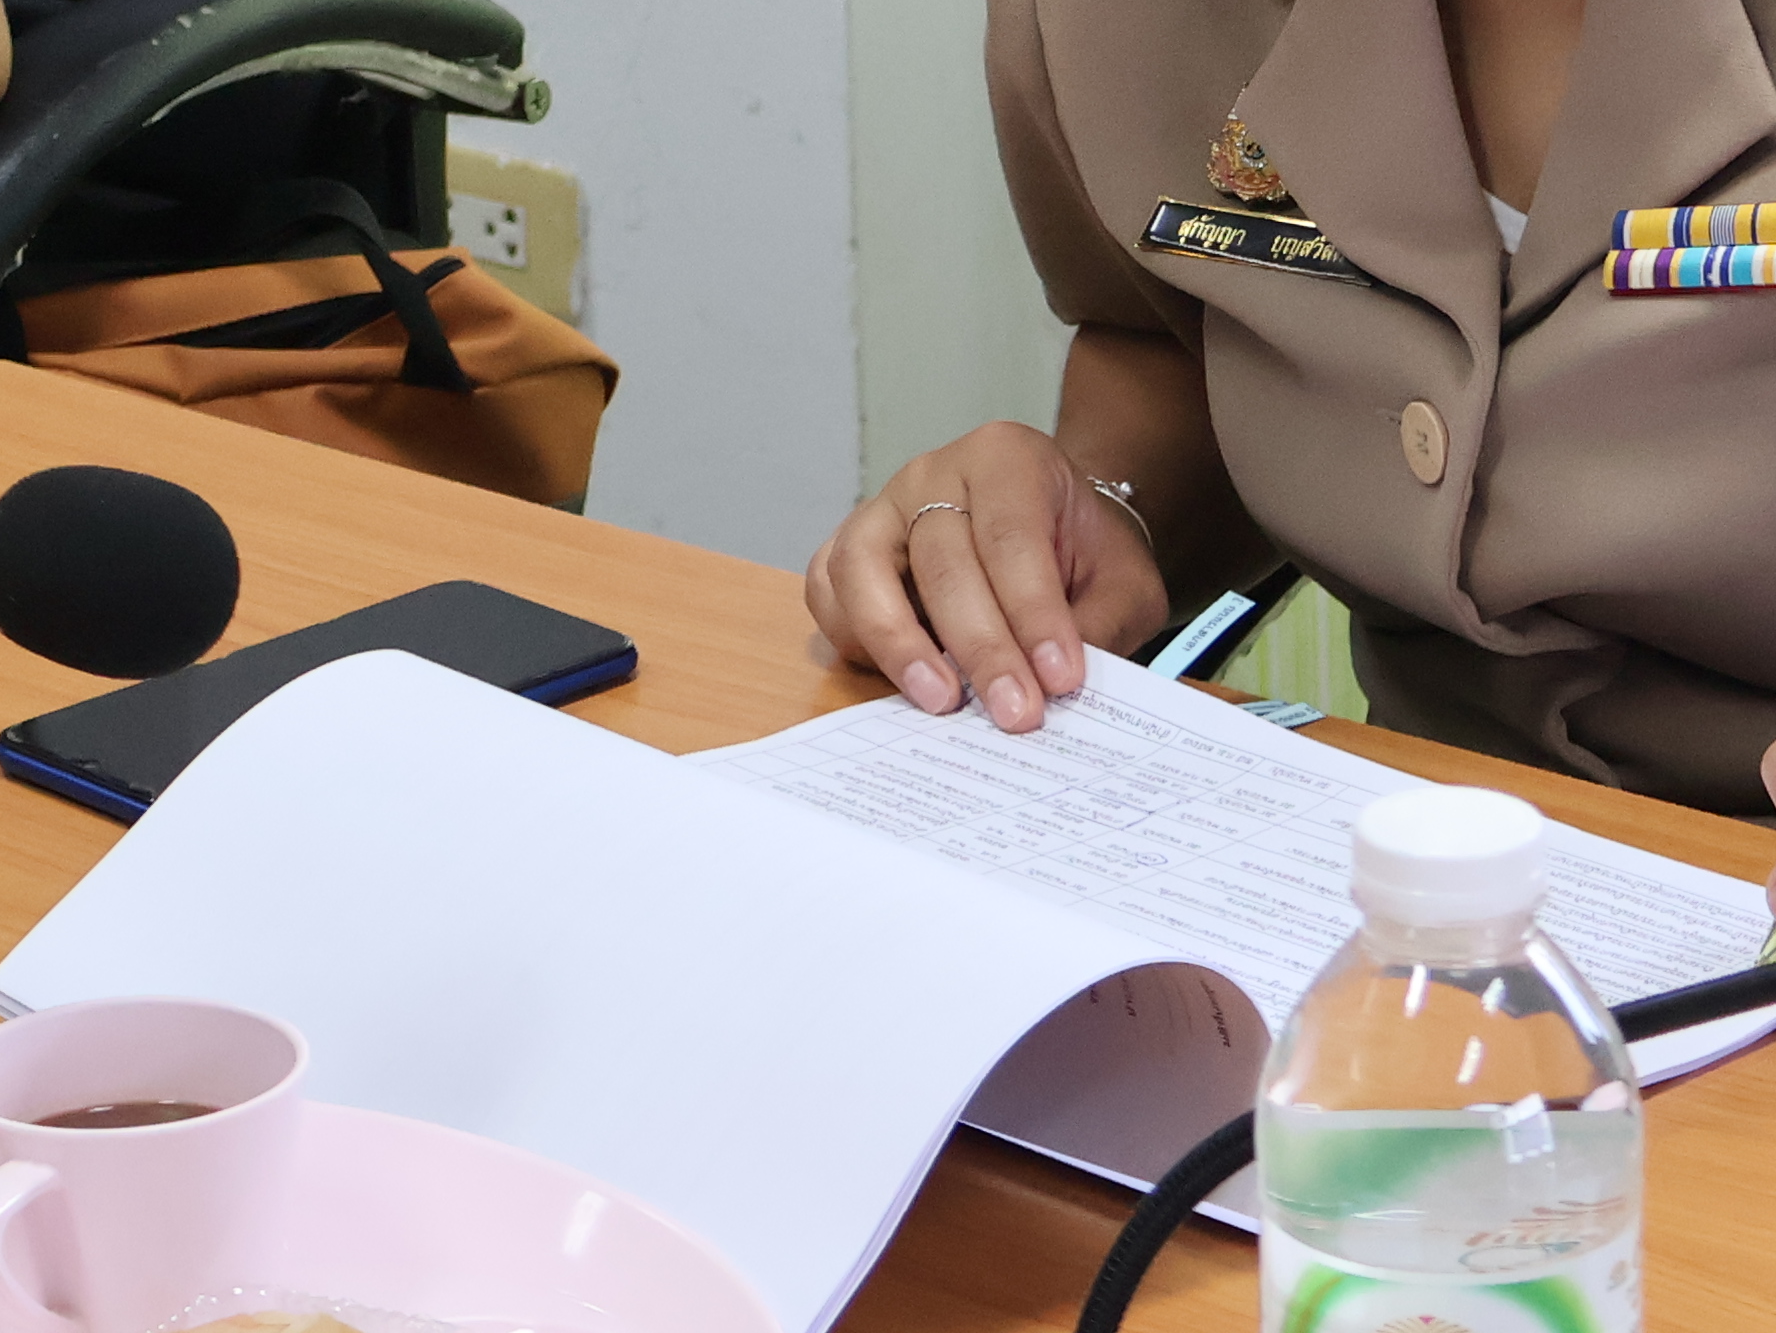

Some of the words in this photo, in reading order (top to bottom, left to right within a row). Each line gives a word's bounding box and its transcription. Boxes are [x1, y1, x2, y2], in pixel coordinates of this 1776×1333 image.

[1177, 213, 1247, 251] สุกัญญา
[1270, 234, 1344, 263] บุญสวัส
